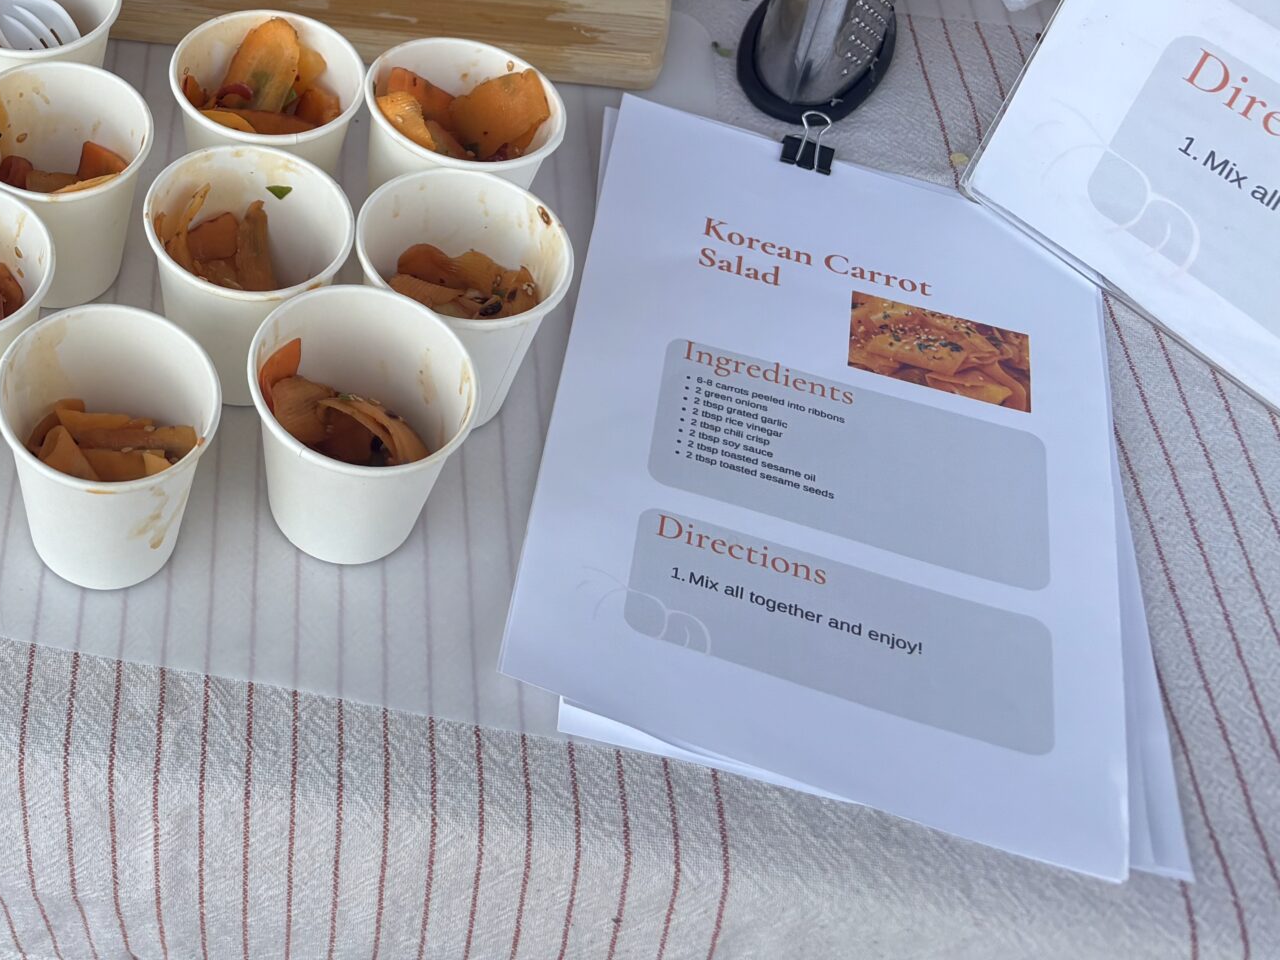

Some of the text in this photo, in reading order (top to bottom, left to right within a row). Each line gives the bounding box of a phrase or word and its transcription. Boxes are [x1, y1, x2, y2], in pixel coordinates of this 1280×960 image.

[1178, 136, 1198, 161] 1.
[1202, 150, 1248, 189] Mix
[698, 247, 781, 287] Salad
[703, 216, 933, 297] Korean Carrot
[683, 340, 854, 405] Ingredients
[694, 397, 788, 429] 2 tbsp grated garlic
[695, 386, 768, 412] 2 green onions
[696, 376, 845, 424] 6-8 carrots peeled into ribbons
[689, 429, 774, 458] 2 tbsp soy sauce
[690, 418, 770, 446] 2 tbsp chili crisp
[692, 407, 783, 438] 2 tbsp rice vinegar
[686, 451, 835, 500] 2 tbsp toasted sesame seeds
[687, 440, 816, 482] 2 tbsp toasted sesame oil
[656, 513, 827, 586] Directions
[671, 566, 923, 655] 1. Mix all together and enjoy!
